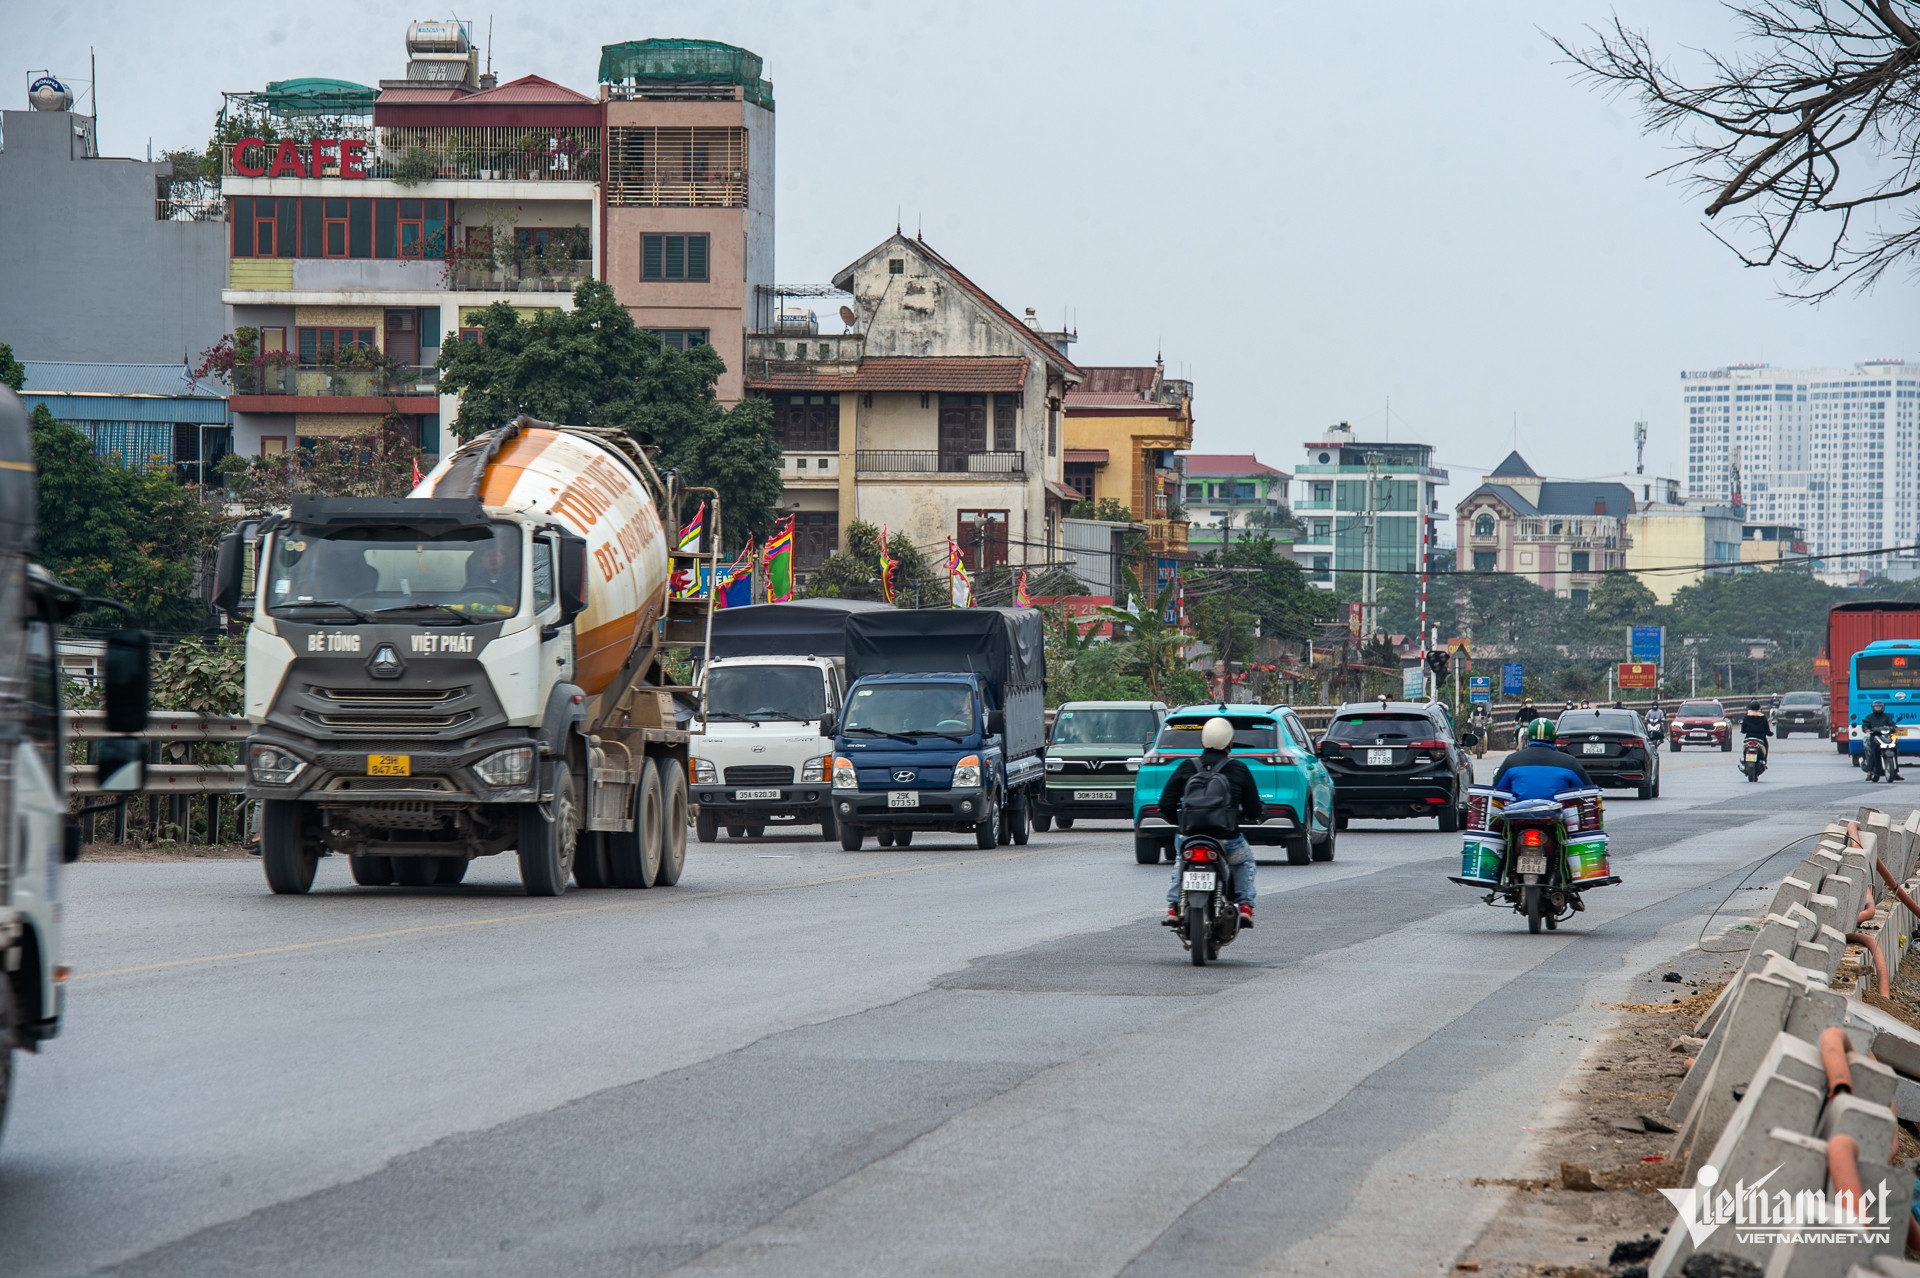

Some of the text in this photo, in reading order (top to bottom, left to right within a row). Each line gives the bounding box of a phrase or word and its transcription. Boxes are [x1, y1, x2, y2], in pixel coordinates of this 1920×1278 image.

[233, 137, 366, 179] CAFE
[327, 631, 361, 651] TÔNG
[411, 631, 475, 655] VIỆT PHÁT
[739, 790, 777, 799] 35A-620.38
[896, 792, 910, 800] 29K
[891, 799, 916, 807] 073.53
